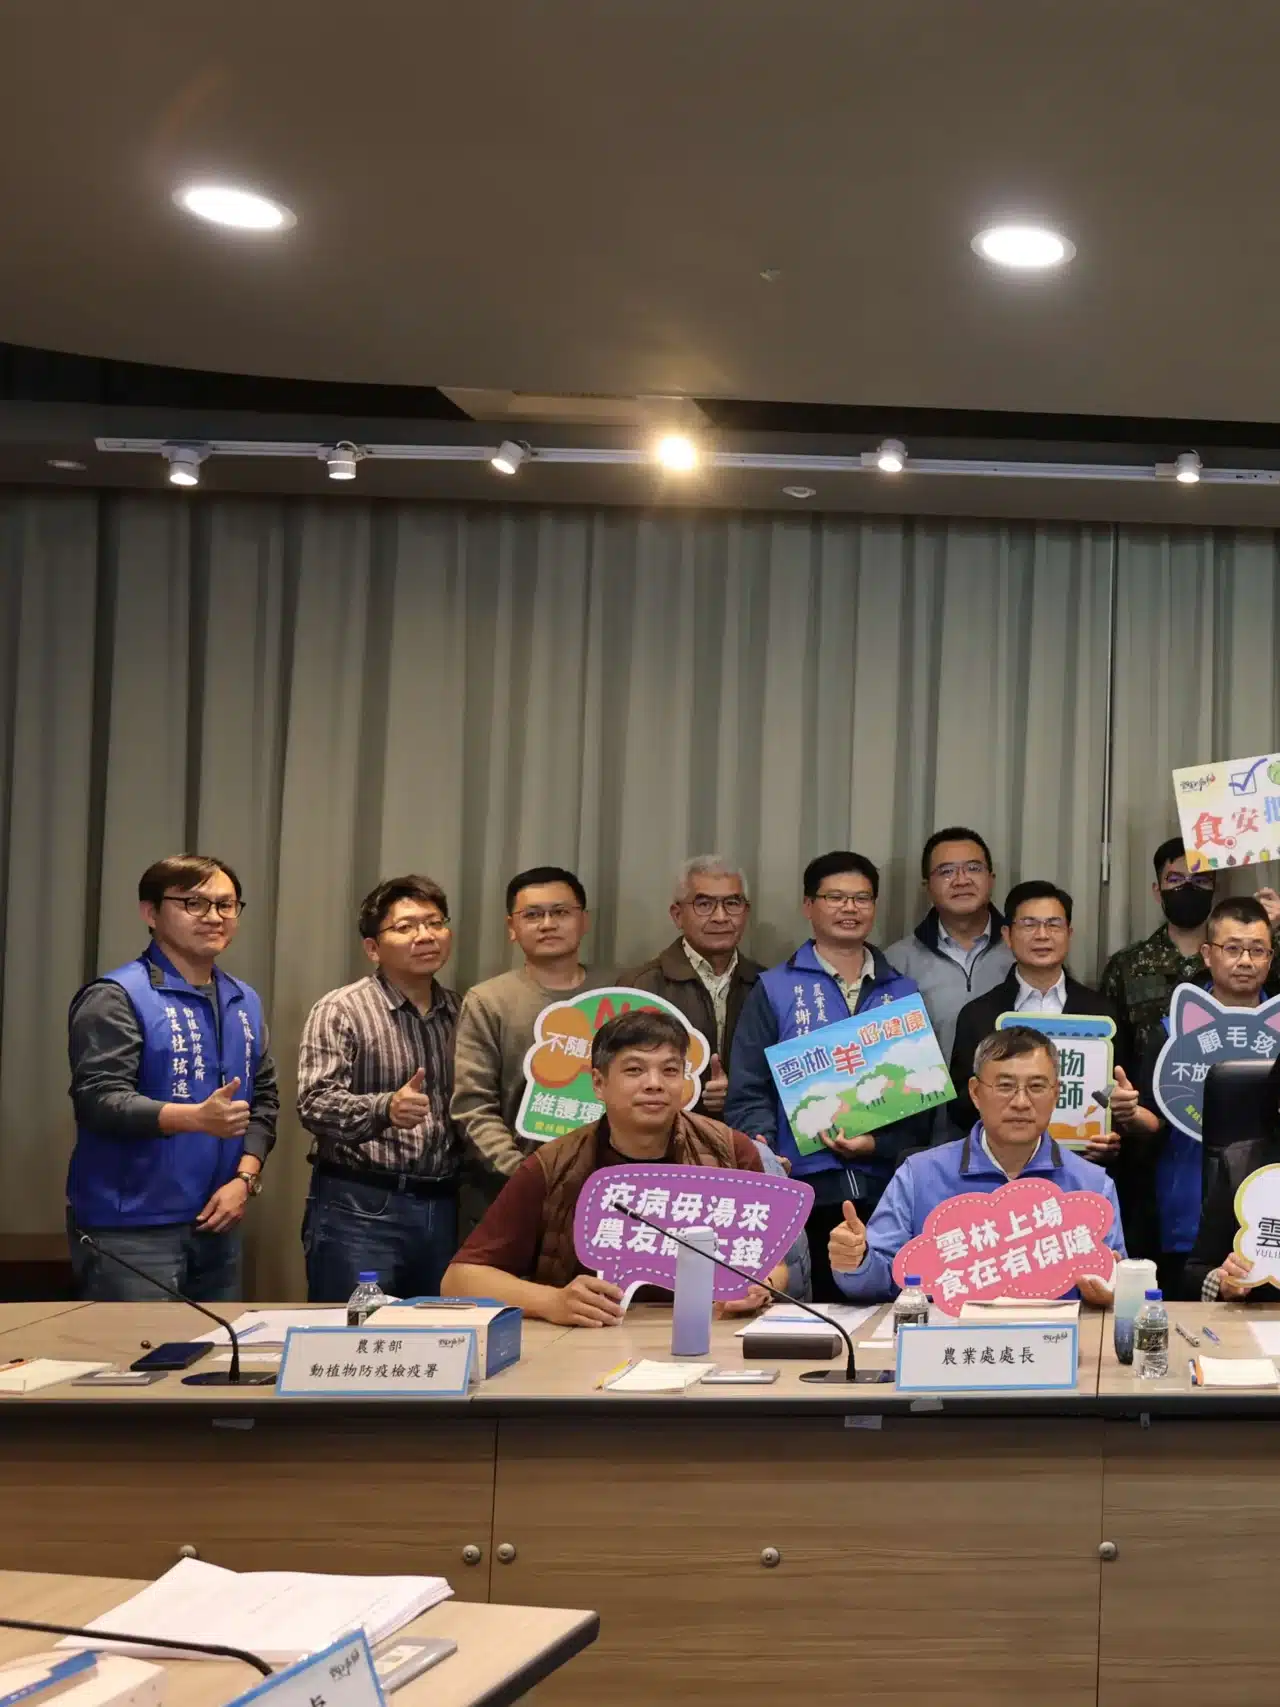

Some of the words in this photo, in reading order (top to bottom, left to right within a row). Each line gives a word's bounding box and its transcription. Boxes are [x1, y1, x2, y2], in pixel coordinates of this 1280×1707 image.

[775, 1010, 926, 1086] 雲林羊好健康
[1197, 1026, 1277, 1057] 顧毛孩
[600, 1182, 770, 1232] 疫病毋湯來
[935, 1197, 1063, 1264] 雲林上場
[934, 1224, 1096, 1302] 食在有保障
[356, 1339, 403, 1354] 農業部
[942, 1346, 1036, 1366] 農業處處長
[309, 1363, 439, 1378] 動植物防疫檢疫署
